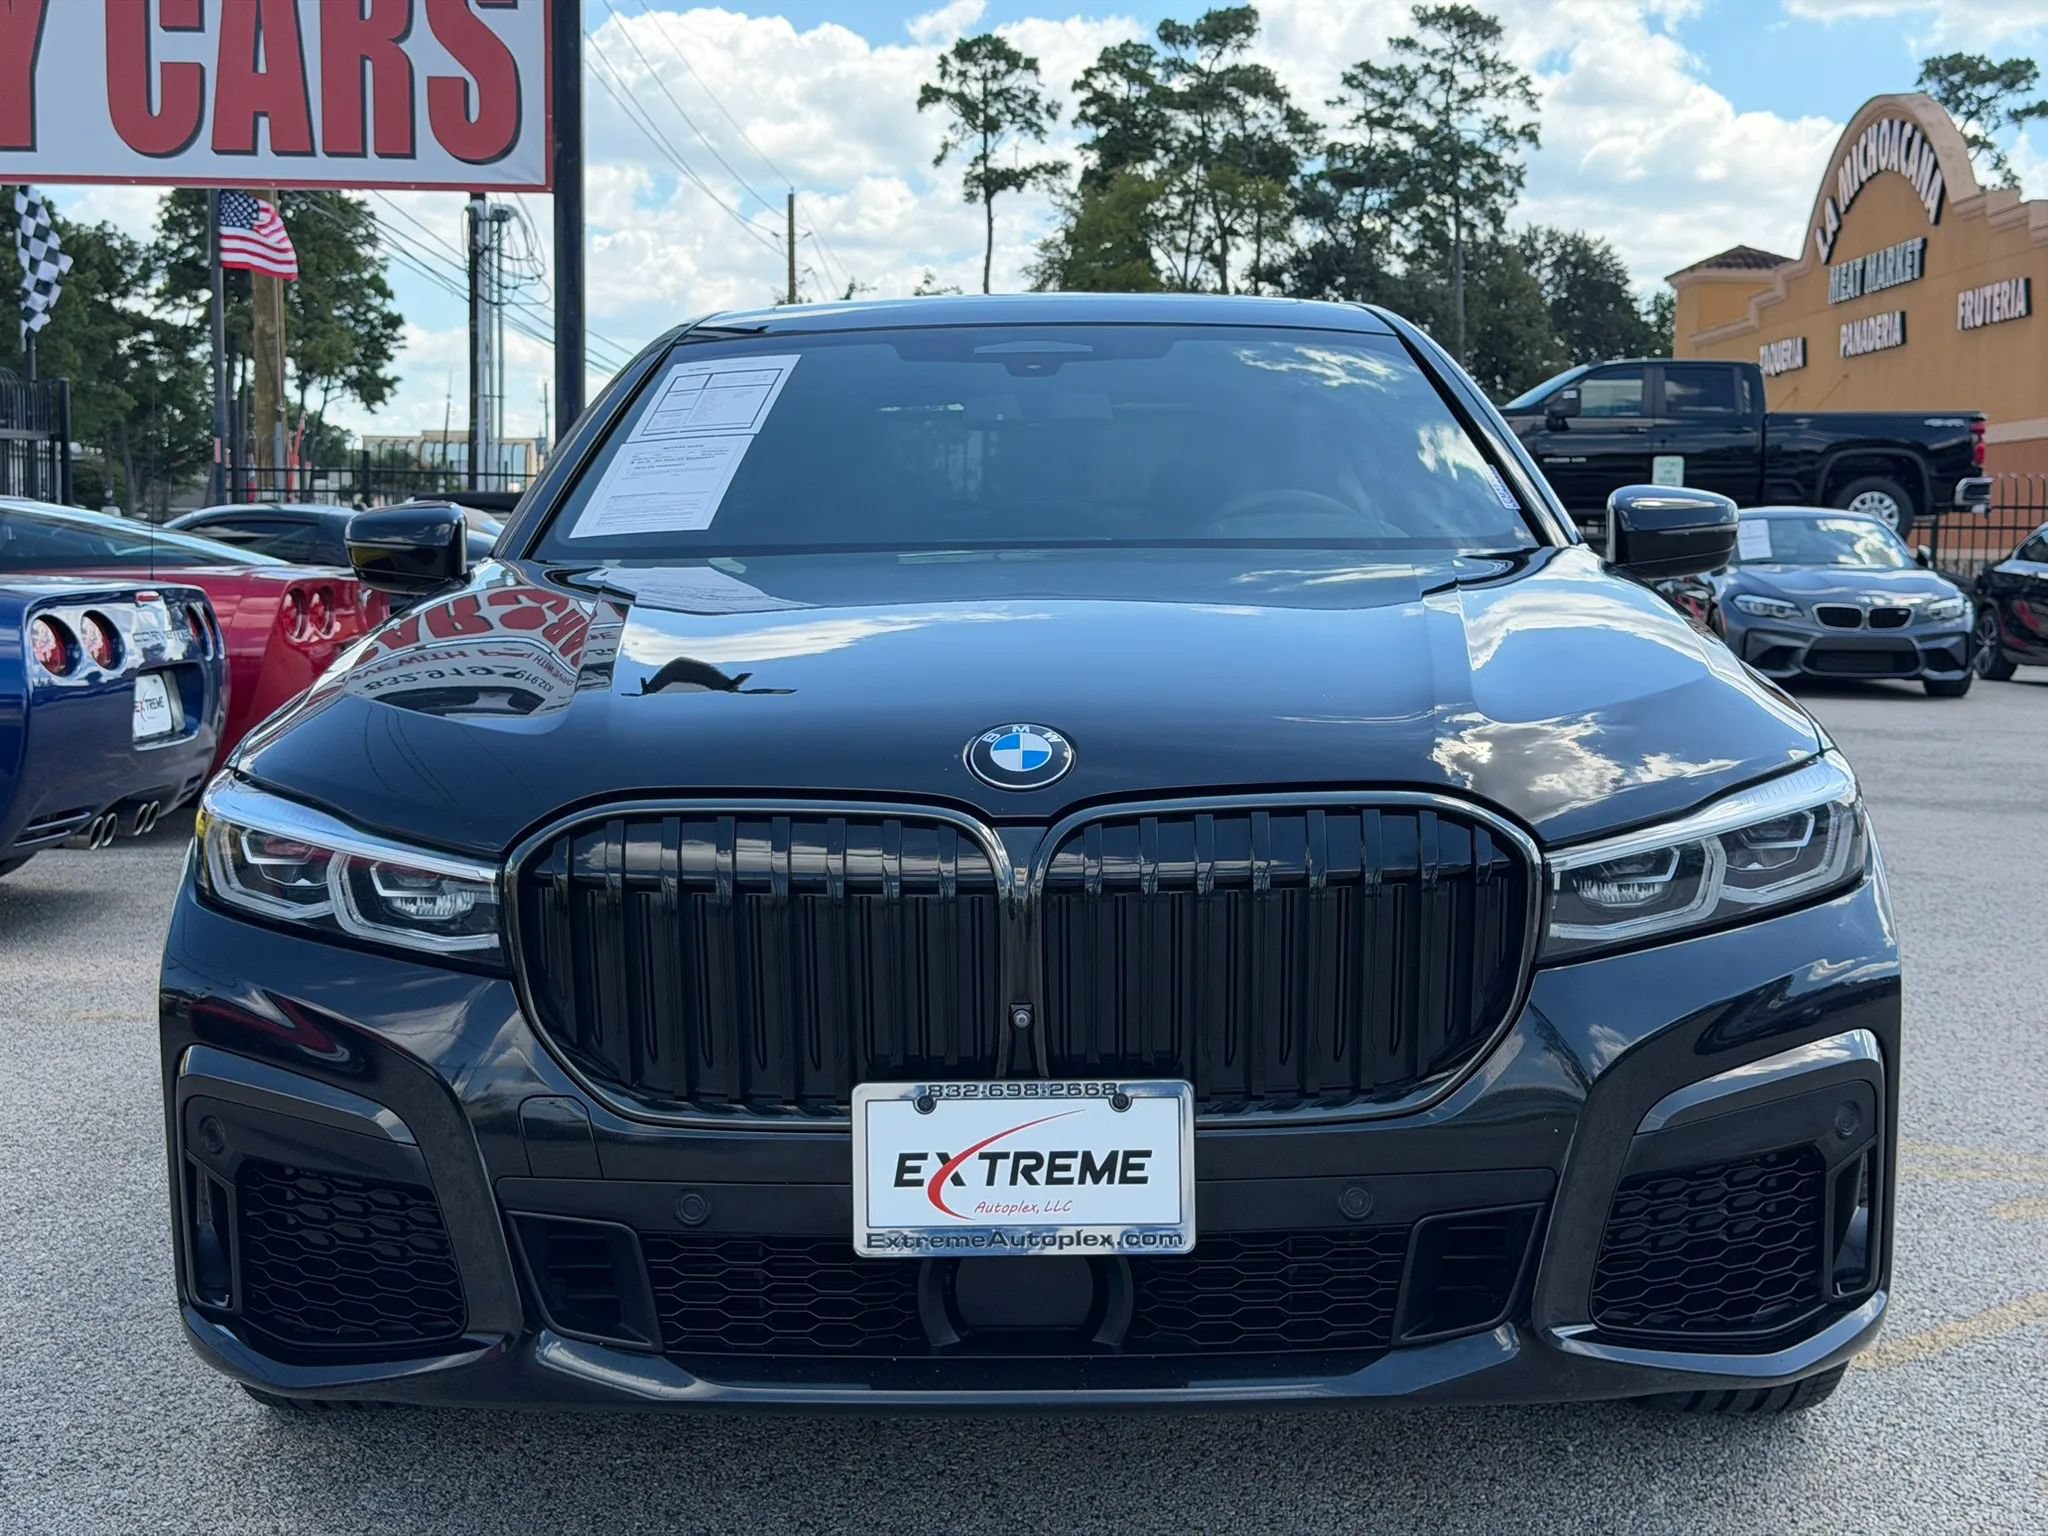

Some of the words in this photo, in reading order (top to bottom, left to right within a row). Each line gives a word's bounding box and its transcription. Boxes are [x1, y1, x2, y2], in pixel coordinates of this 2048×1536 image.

[104, 0, 522, 165] CARS
[1815, 197, 1840, 265] LA
[1837, 118, 1944, 225] MICHOACANA
[1828, 258, 1864, 304] MEAT
[1863, 236, 1924, 294] MARKET
[1957, 276, 2029, 330] FRUTERIA
[1839, 310, 1903, 358] PANADERIA
[981, 724, 1063, 743] BMW
[893, 1149, 1153, 1188] EXTREME
[975, 1200, 1040, 1217] Autoplex,
[1043, 1200, 1072, 1213] LLC
[865, 1229, 1184, 1251] ExtremeAutoplex.com
